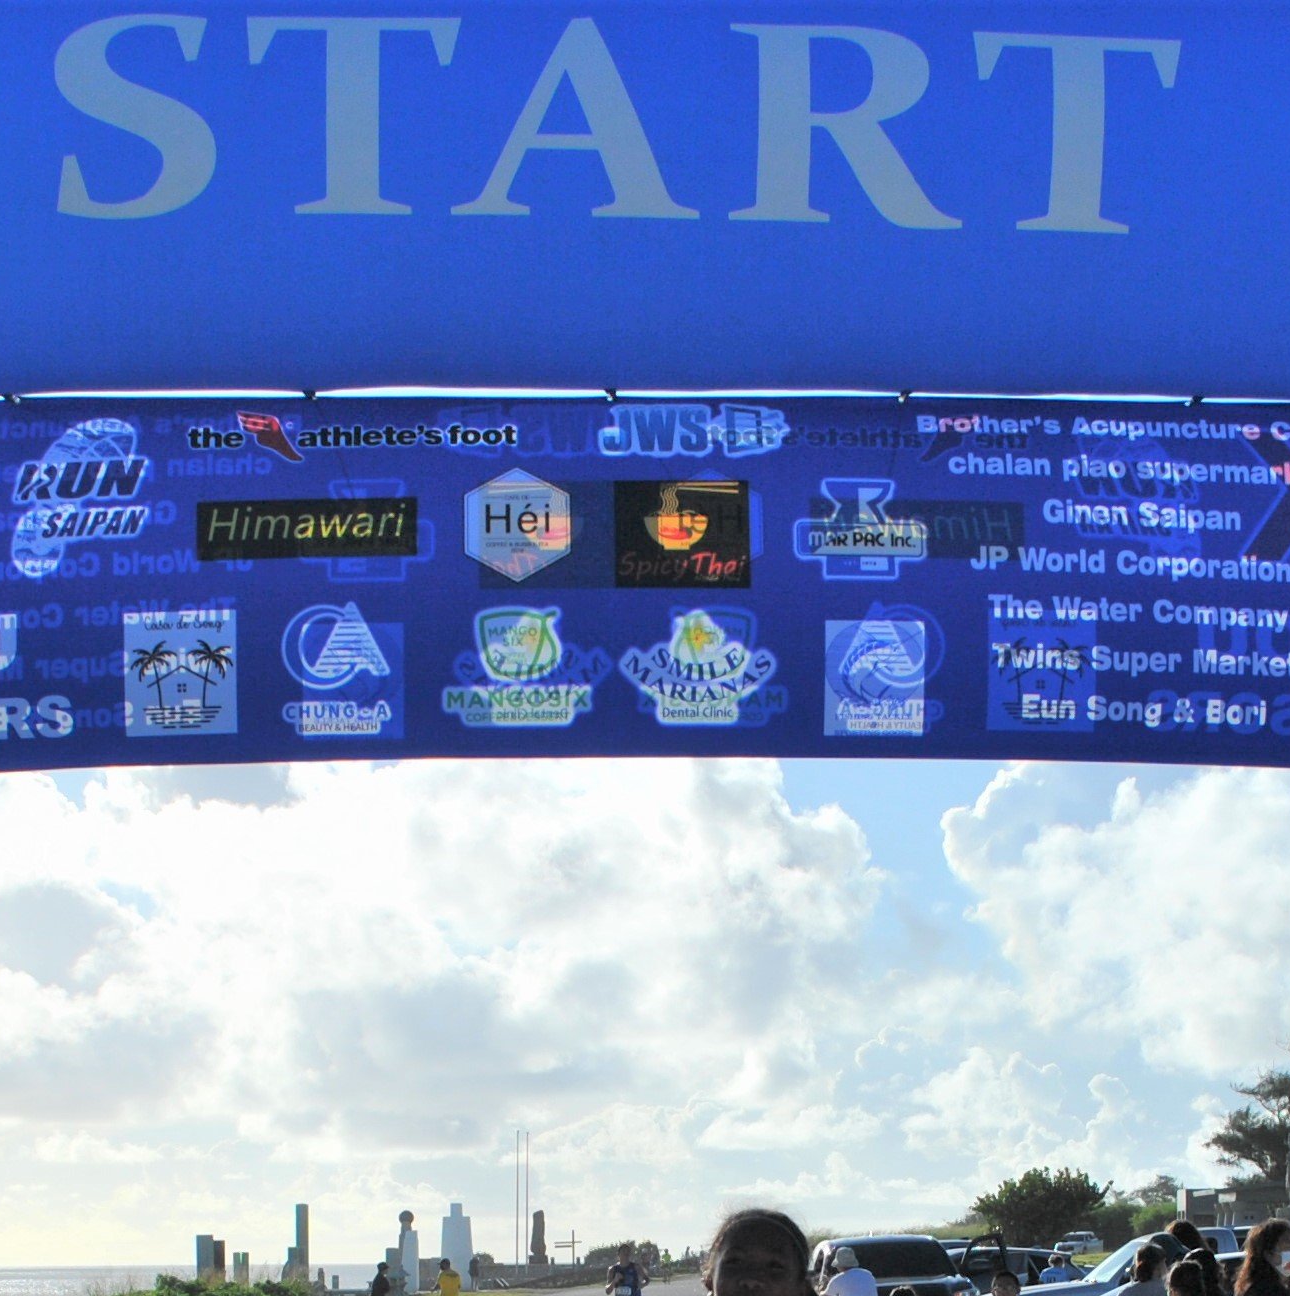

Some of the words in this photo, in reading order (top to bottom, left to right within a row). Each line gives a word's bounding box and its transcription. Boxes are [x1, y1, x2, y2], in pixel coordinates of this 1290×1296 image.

[53, 12, 1183, 236] START
[187, 426, 244, 449] the
[298, 424, 443, 448] athlete's
[446, 423, 517, 447] foot
[602, 408, 709, 453] JWS
[916, 414, 1060, 435] Brother's
[1071, 416, 1261, 441] Acupuncture
[14, 458, 147, 501] RUN
[948, 452, 1051, 477] chalan
[1062, 453, 1128, 482] piao
[42, 507, 147, 539] SAIPAN
[208, 503, 407, 542] Himawari
[485, 503, 551, 534] Héi
[1043, 498, 1129, 527] Ginen
[1139, 501, 1242, 535] Saipan
[853, 531, 885, 547] PAC
[970, 545, 1010, 571] JP
[1018, 546, 1106, 575] World
[988, 593, 1043, 620] The
[1052, 595, 1143, 623] Water
[1153, 598, 1289, 633] Company
[652, 647, 744, 682] SMILE
[992, 642, 1081, 671] Twins
[1091, 645, 1182, 677] Super
[625, 654, 771, 702] MARIANAS
[446, 689, 589, 709] MANGOSIX
[662, 706, 699, 718] Dental
[702, 706, 734, 718] Clinic
[1021, 693, 1076, 720] Eun
[1087, 695, 1163, 728] Song
[1174, 697, 1196, 724] &
[1206, 699, 1267, 726] Bori
[299, 723, 333, 732] BEAUTY
